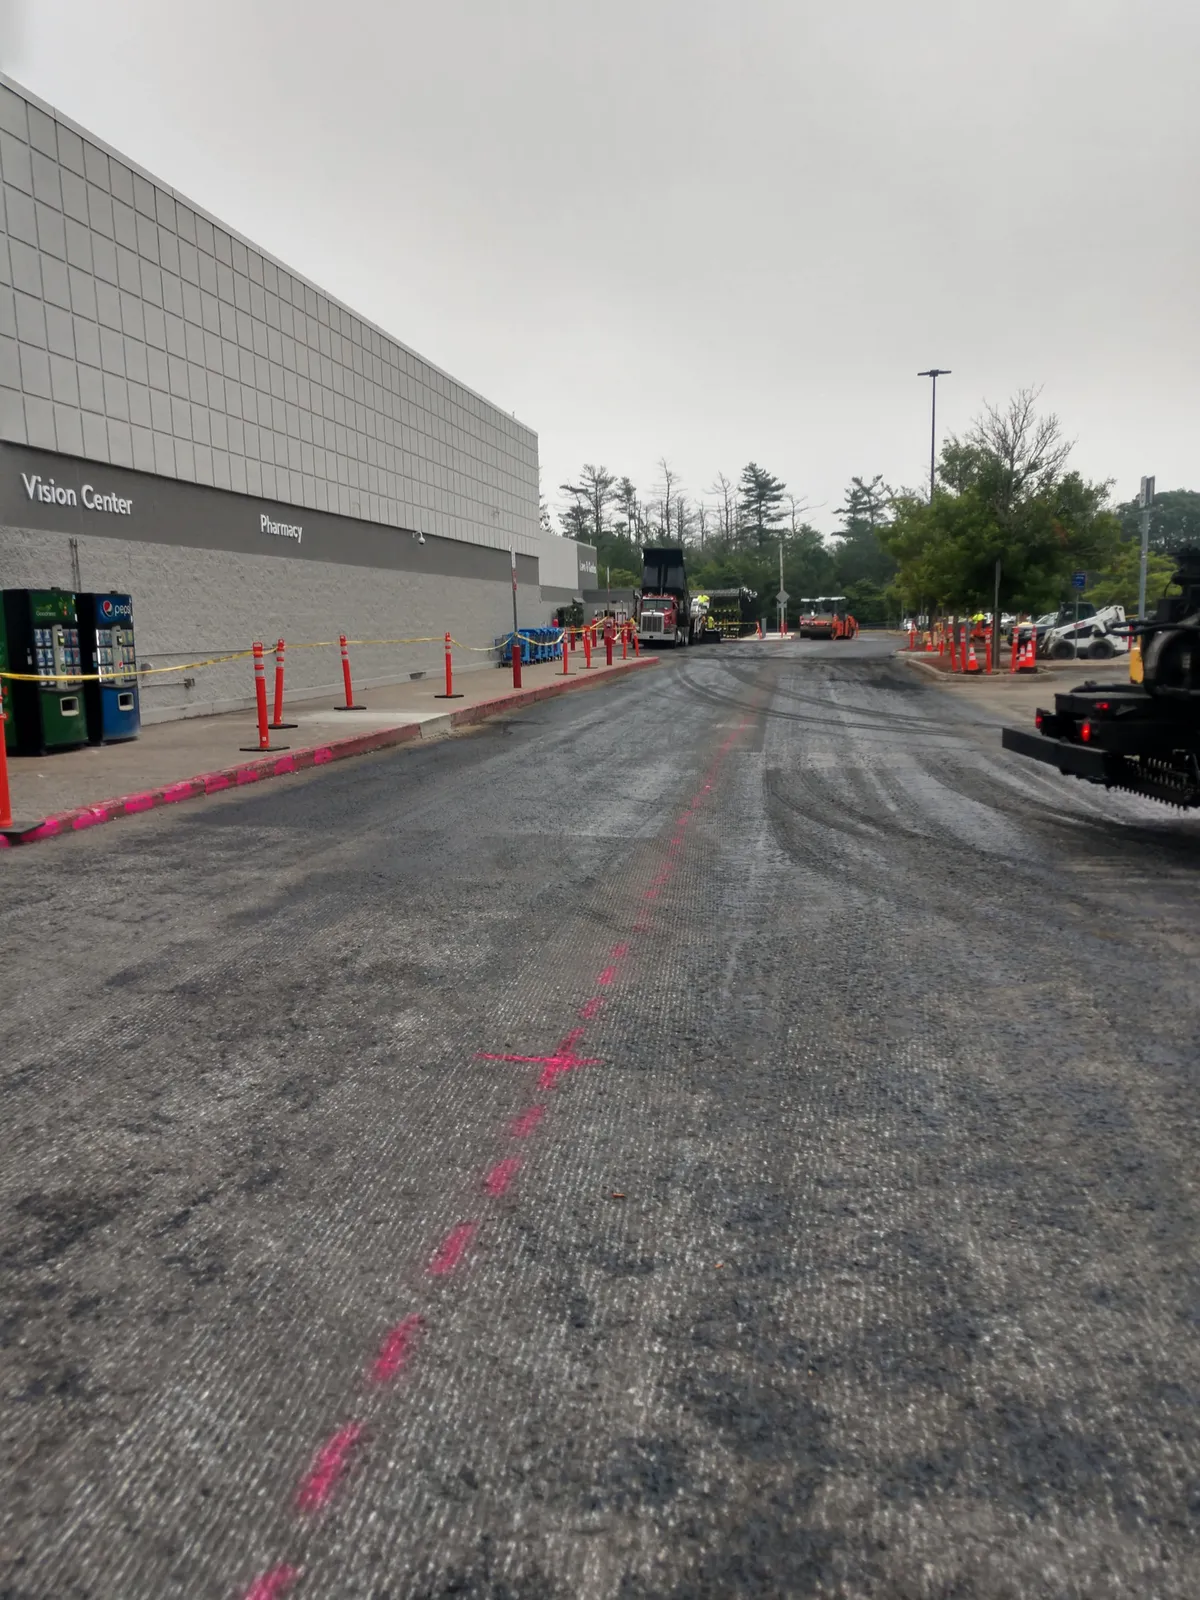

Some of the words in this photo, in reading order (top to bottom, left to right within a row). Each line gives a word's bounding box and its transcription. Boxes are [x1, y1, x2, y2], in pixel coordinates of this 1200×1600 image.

[21, 473, 77, 506] Vision
[81, 484, 132, 515] Center
[260, 514, 303, 543] Pharmacy
[114, 604, 132, 617] peps
